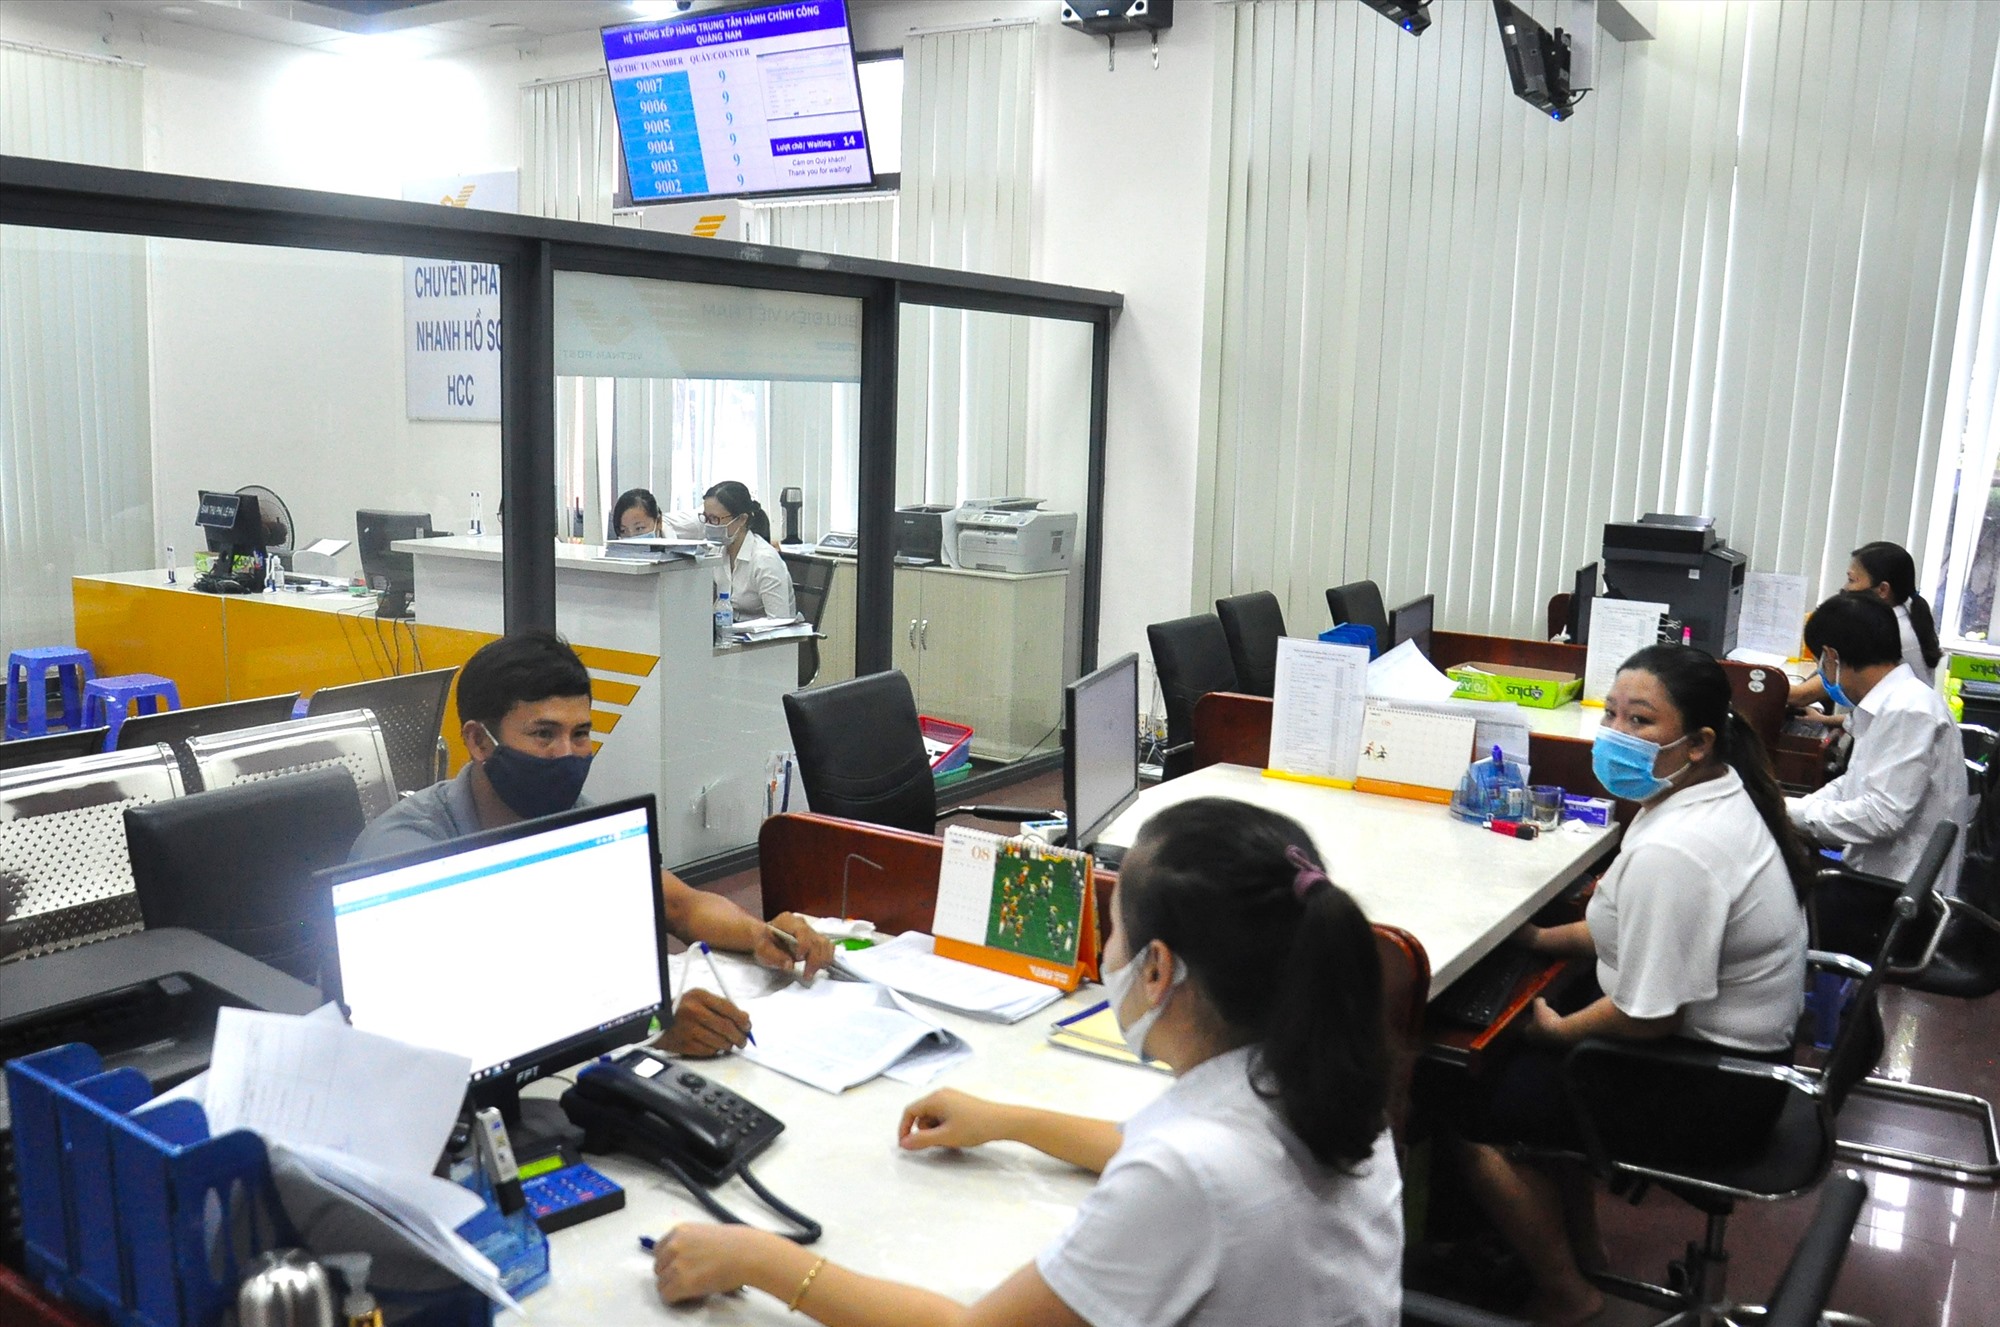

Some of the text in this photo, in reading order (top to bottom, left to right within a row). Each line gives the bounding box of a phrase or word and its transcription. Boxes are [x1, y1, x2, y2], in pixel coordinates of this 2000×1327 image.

[623, 32, 633, 44] HỆ
[634, 28, 659, 41] THỐNG
[676, 22, 697, 36] HÀNG
[698, 19, 724, 31] TRUNG
[725, 16, 742, 27] TÂM
[744, 12, 766, 25] HÀNH
[768, 8, 794, 22] CHÍNH
[796, 5, 820, 17] CÔNG
[724, 29, 742, 41] NAM
[636, 70, 726, 93] 9007 9
[640, 91, 729, 114] 9006 9
[643, 112, 733, 134] 9005 9
[647, 133, 737, 154] 9004 9
[807, 139, 832, 149] Waiting
[843, 135, 856, 147] 14
[651, 153, 740, 174] 9003 9
[788, 168, 806, 177] Thank
[807, 168, 818, 177] you
[829, 165, 852, 174] waiting!
[655, 174, 744, 194] 9002 9
[416, 319, 461, 352] NHANH
[464, 307, 484, 352] HỒ
[447, 373, 475, 407] HCC
[1506, 685, 1531, 699] plus
[971, 844, 991, 861] 08
[516, 1065, 539, 1083] FPT
